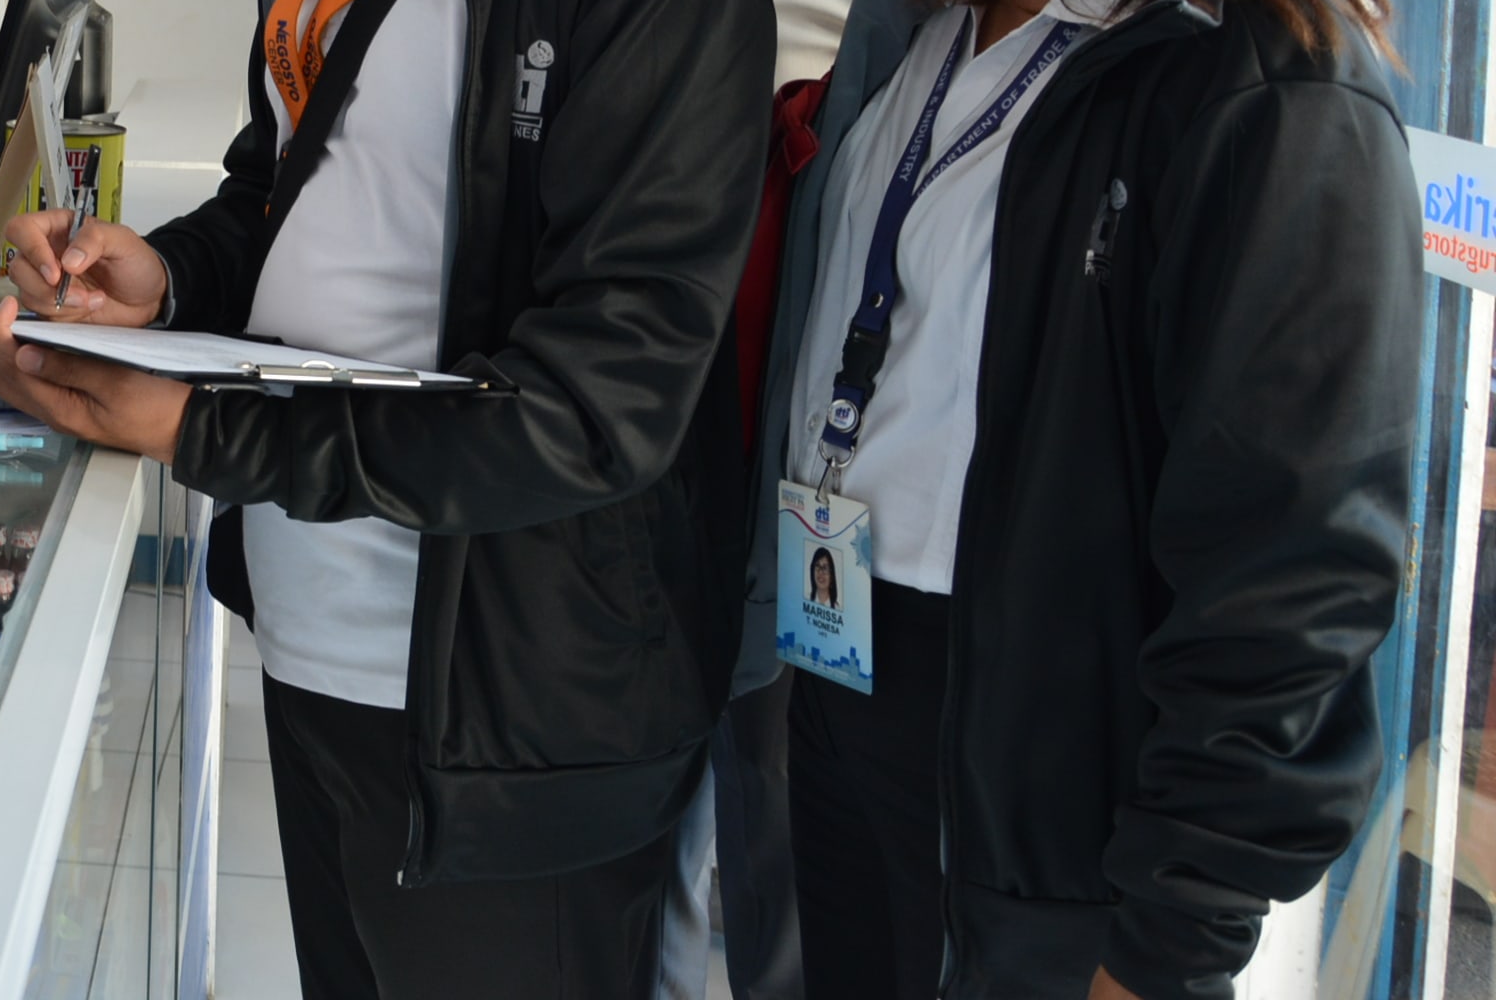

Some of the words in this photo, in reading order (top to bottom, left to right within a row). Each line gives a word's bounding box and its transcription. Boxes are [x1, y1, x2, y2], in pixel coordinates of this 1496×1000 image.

[268, 39, 284, 86] CENTER
[277, 19, 300, 103] NEGOSYO
[1001, 89, 1019, 110] OF
[1022, 41, 1066, 88] TRADE
[900, 109, 934, 182] INDUSTRY
[802, 602, 844, 627] MARISSA
